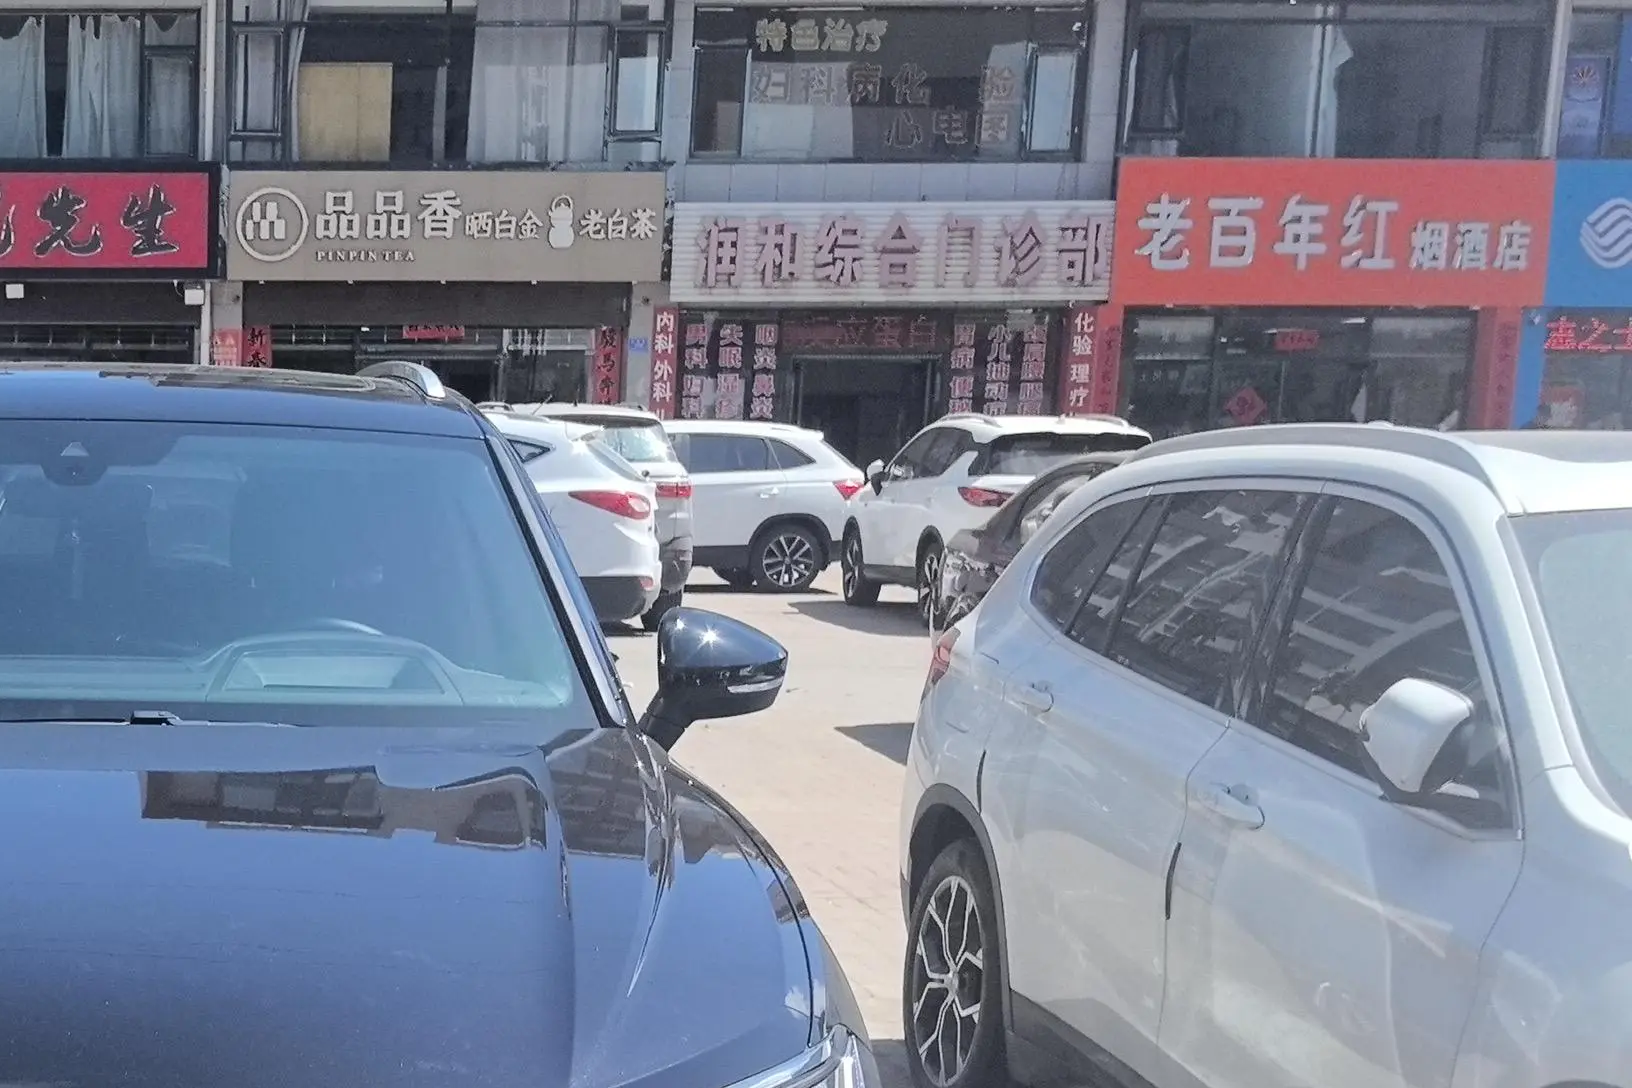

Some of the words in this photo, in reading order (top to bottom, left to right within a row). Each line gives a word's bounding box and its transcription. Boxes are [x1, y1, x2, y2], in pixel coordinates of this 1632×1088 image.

[755, 18, 888, 52] 特色治疗
[315, 190, 462, 240] 品品香
[465, 208, 544, 241] 晒白金
[579, 208, 658, 240] 老白茶
[1134, 193, 1399, 271] 老百年红
[1410, 219, 1532, 272] 烟酒店
[316, 251, 377, 262] PINPIN
[382, 251, 416, 262] TEA
[694, 212, 1113, 288] 润和综合门诊部
